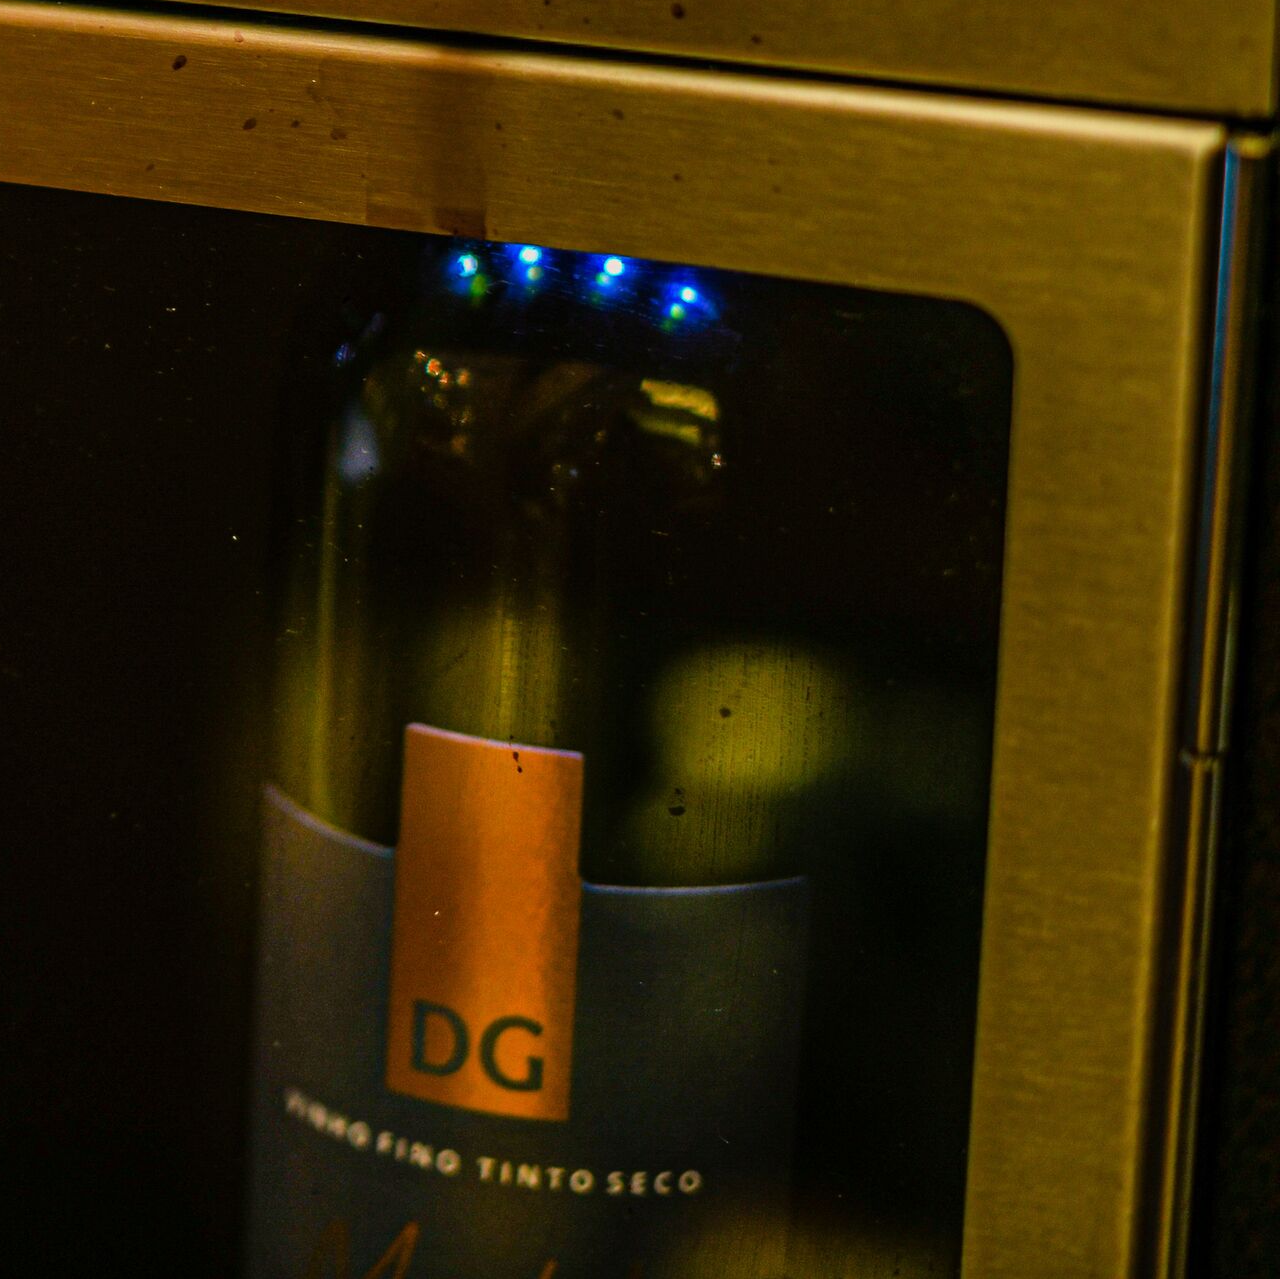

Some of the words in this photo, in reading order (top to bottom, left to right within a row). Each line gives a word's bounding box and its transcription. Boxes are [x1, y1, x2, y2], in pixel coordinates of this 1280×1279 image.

[408, 998, 544, 1094] DG
[374, 1129, 462, 1178] FINO
[476, 1154, 596, 1195] TINTO
[604, 1168, 704, 1197] SECO
